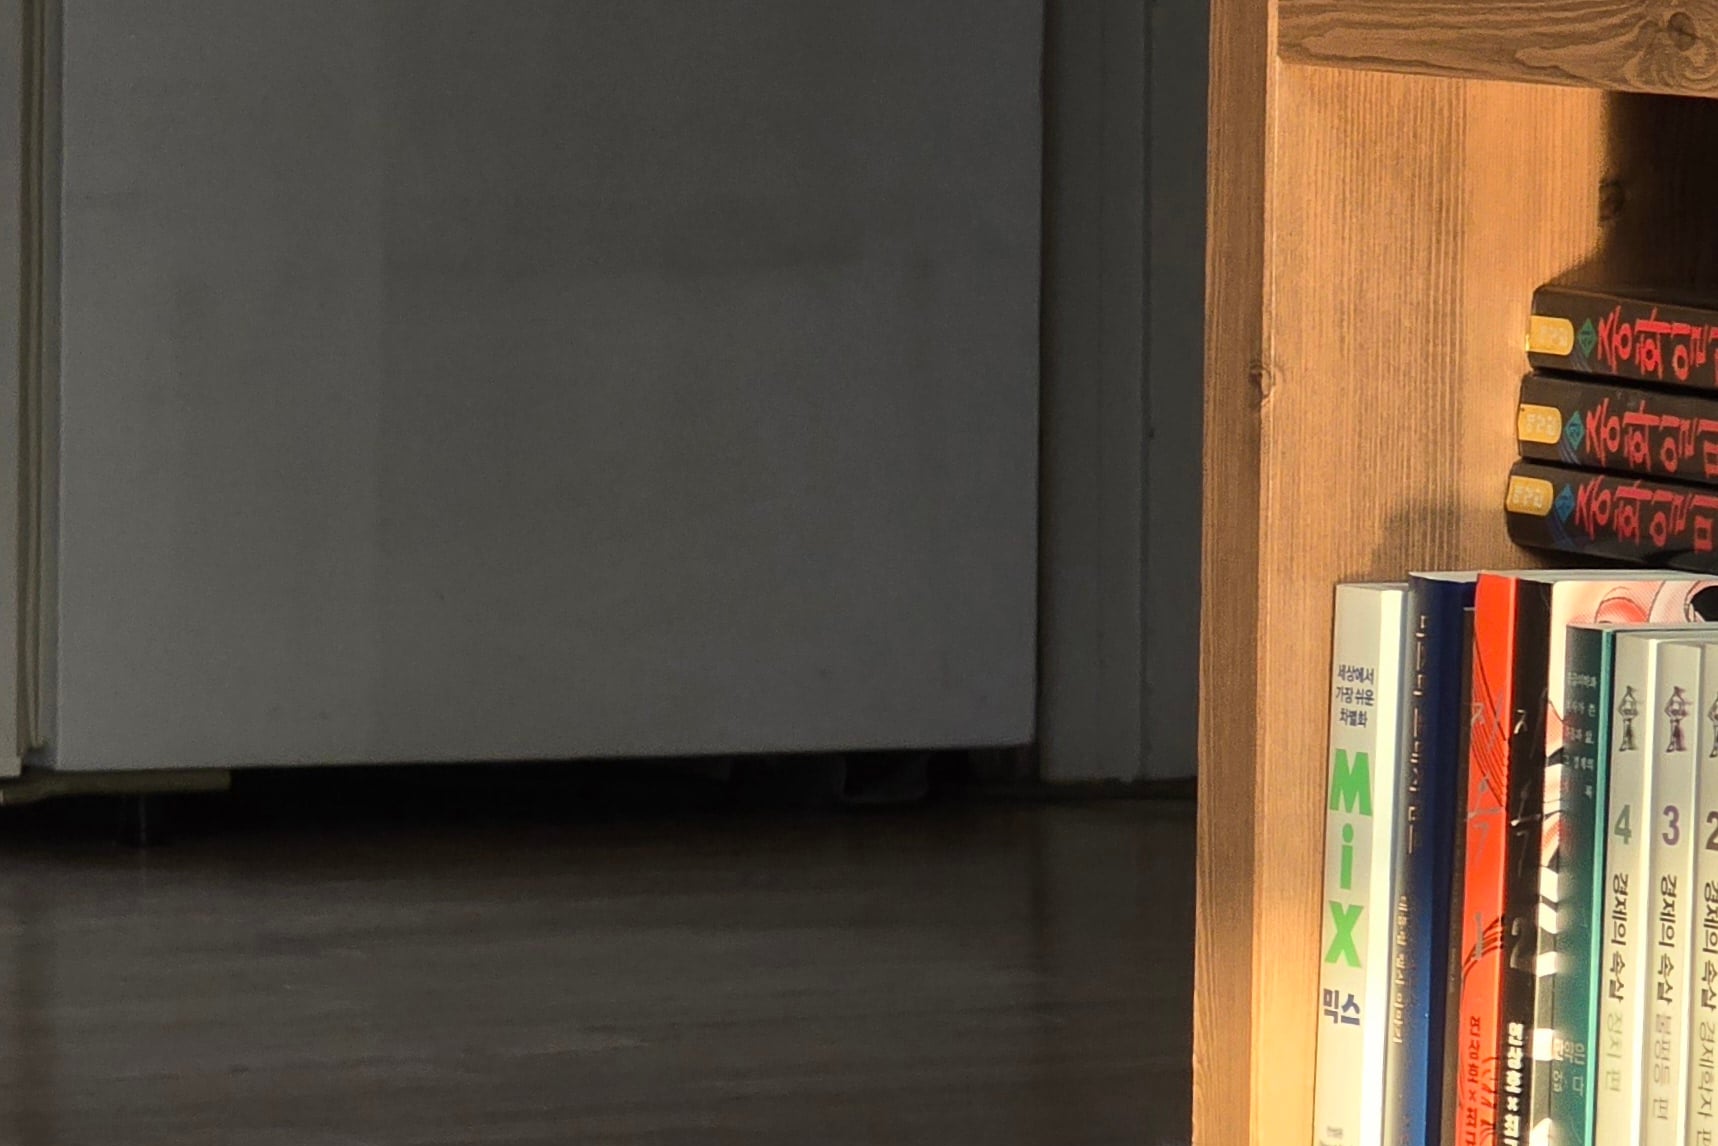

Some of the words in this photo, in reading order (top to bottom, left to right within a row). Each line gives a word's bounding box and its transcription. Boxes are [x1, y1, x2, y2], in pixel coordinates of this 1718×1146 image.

[1597, 305, 1718, 386] 중화일
[1336, 686, 1353, 704] 가장
[1355, 688, 1375, 707] 쉬운
[1338, 664, 1374, 685] 세상에서
[1339, 707, 1368, 728] 차별화
[1614, 804, 1632, 845] 4
[1662, 804, 1680, 846] 3
[1705, 810, 1718, 852] 2
[1610, 872, 1629, 946] 경제의
[1658, 873, 1678, 948] 경제의
[1702, 880, 1718, 955] 경제의
[1608, 951, 1626, 1003] 속살
[1656, 953, 1675, 1006] 속살
[1700, 960, 1718, 1012] 속살
[1323, 988, 1361, 1026] 믹스
[1696, 1021, 1716, 1119] 경제학자
